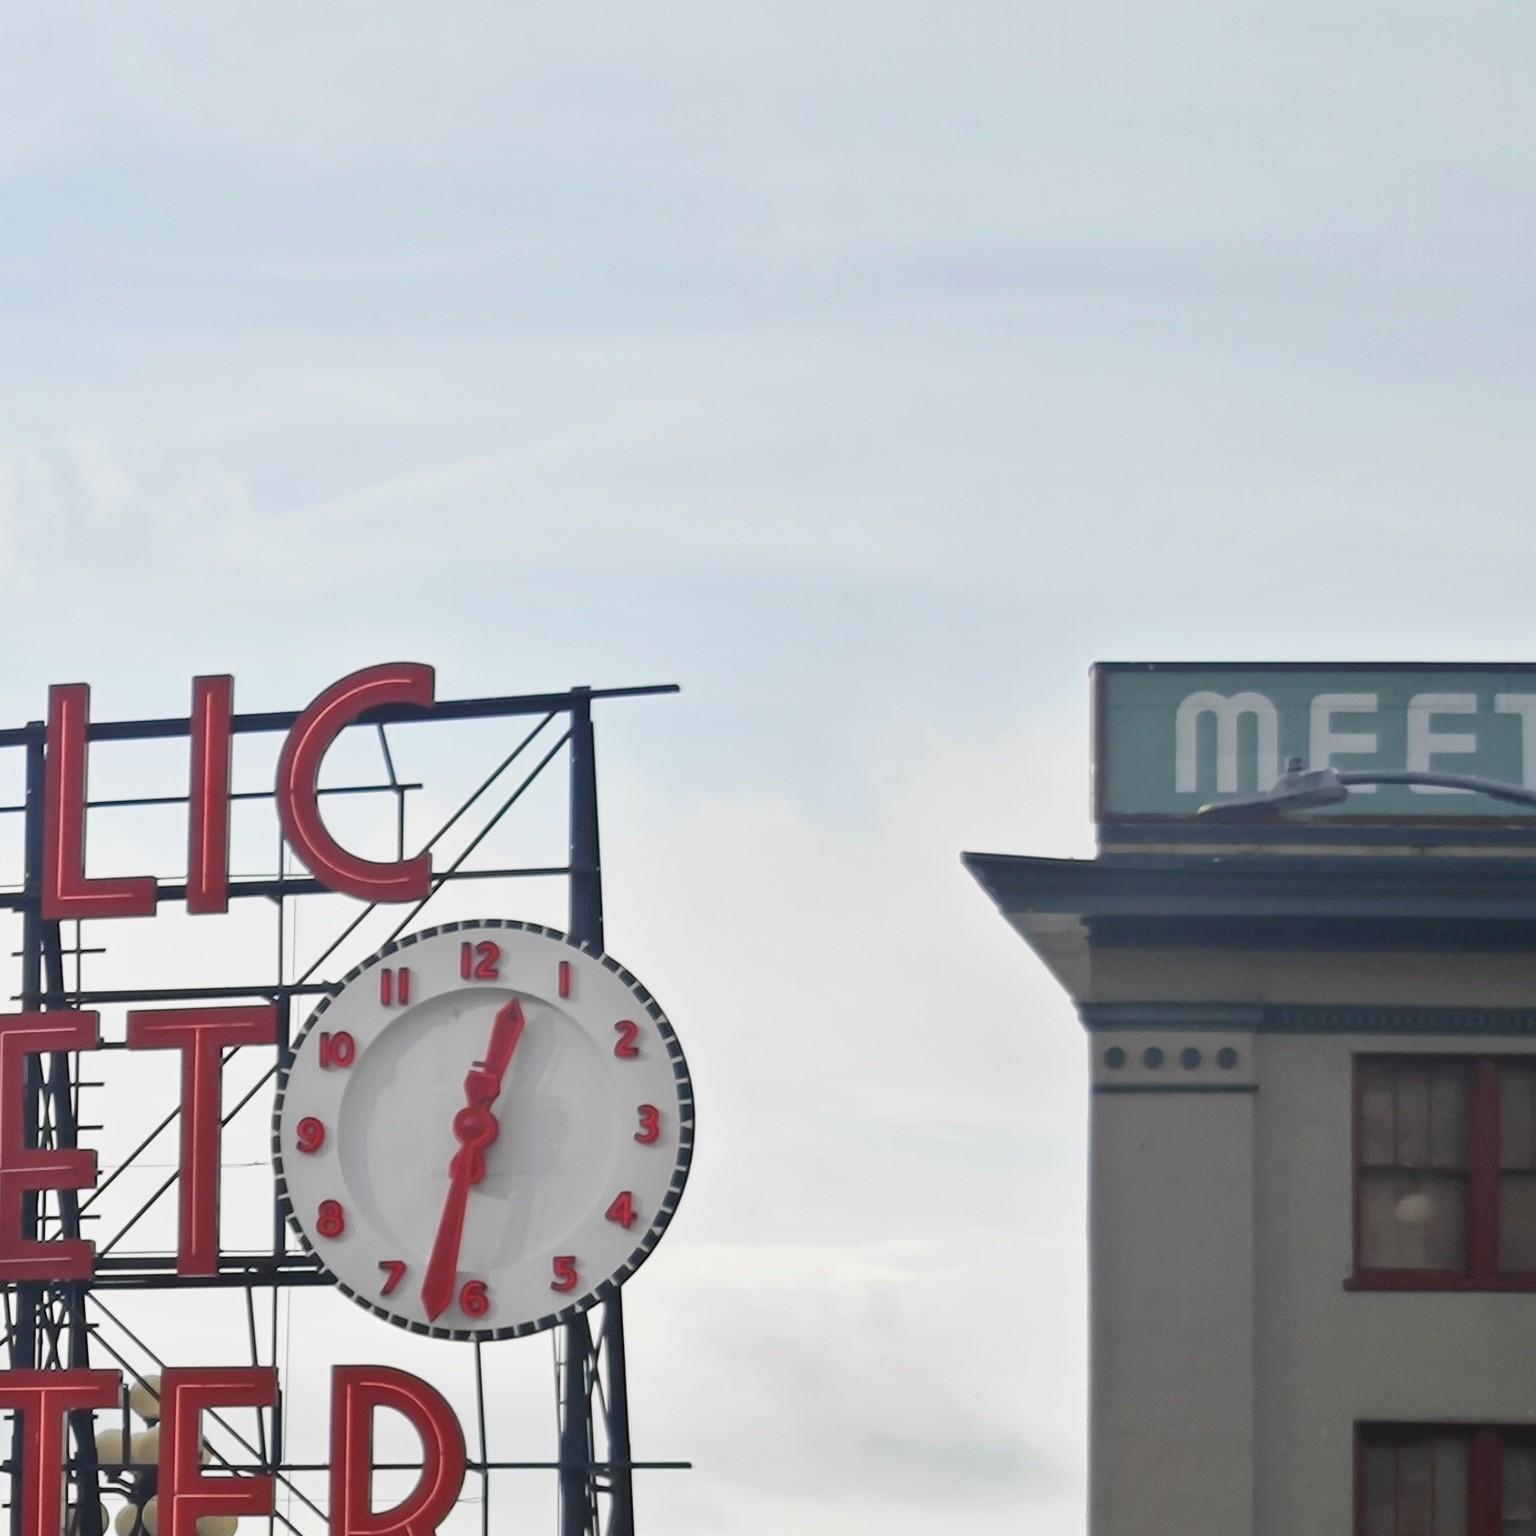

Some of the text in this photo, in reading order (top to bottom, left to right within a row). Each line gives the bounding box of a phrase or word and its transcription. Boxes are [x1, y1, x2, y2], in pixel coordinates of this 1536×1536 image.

[460, 941, 501, 980] 12
[380, 967, 410, 1006] 11
[559, 961, 570, 999] 1
[319, 1031, 356, 1070] 10
[614, 1020, 639, 1059] 2
[296, 1116, 326, 1153] 9
[634, 1104, 660, 1145] 3
[316, 1200, 345, 1238] 8
[605, 1191, 637, 1229] 4
[378, 1260, 407, 1296] 7
[550, 1256, 579, 1292] 5
[459, 1280, 490, 1318] 6
